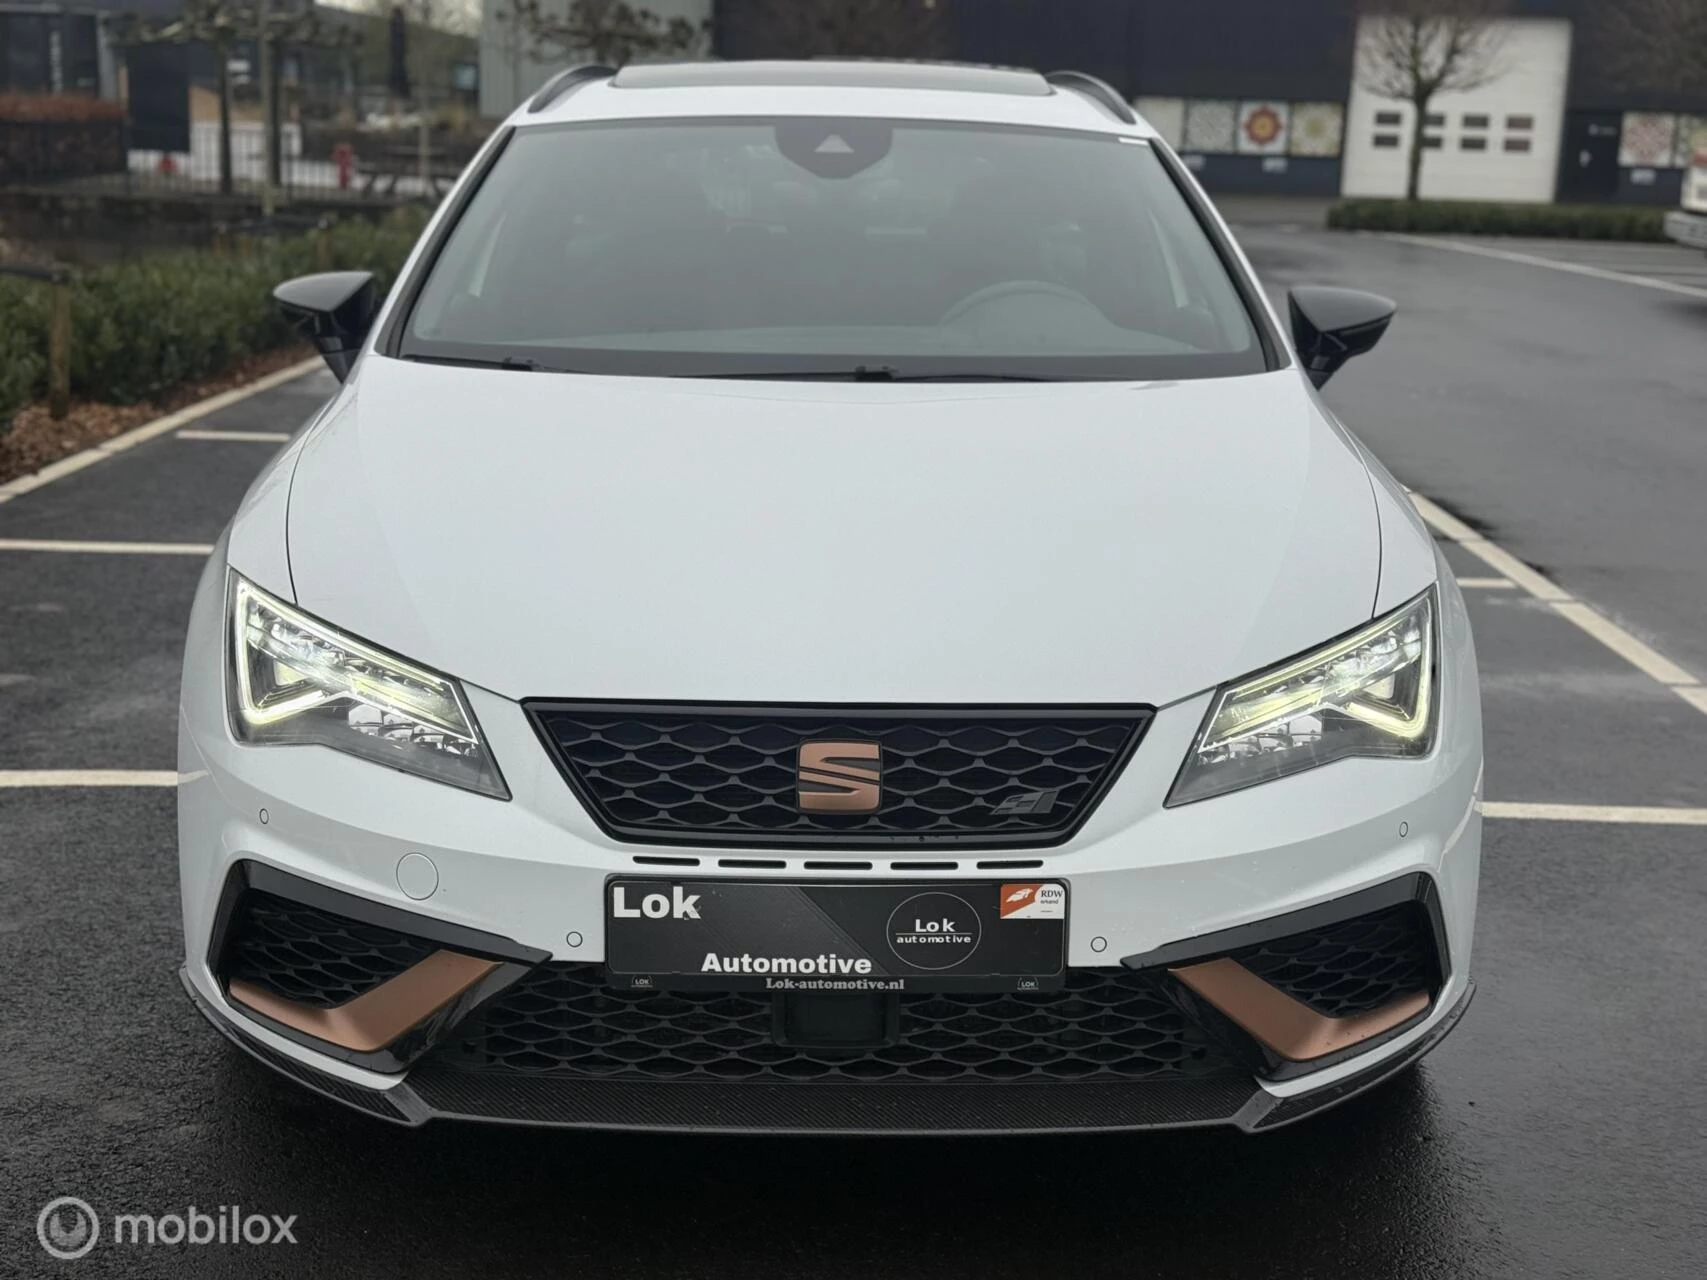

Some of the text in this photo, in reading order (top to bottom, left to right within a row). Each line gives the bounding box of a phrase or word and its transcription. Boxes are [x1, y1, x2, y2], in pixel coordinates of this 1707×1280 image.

[1041, 889, 1063, 898] RDW
[613, 886, 702, 919] Lok
[914, 918, 956, 933] Lok
[895, 934, 972, 945] automotive
[701, 953, 872, 975] Automotive
[765, 977, 906, 991] Lok-automotive.nl
